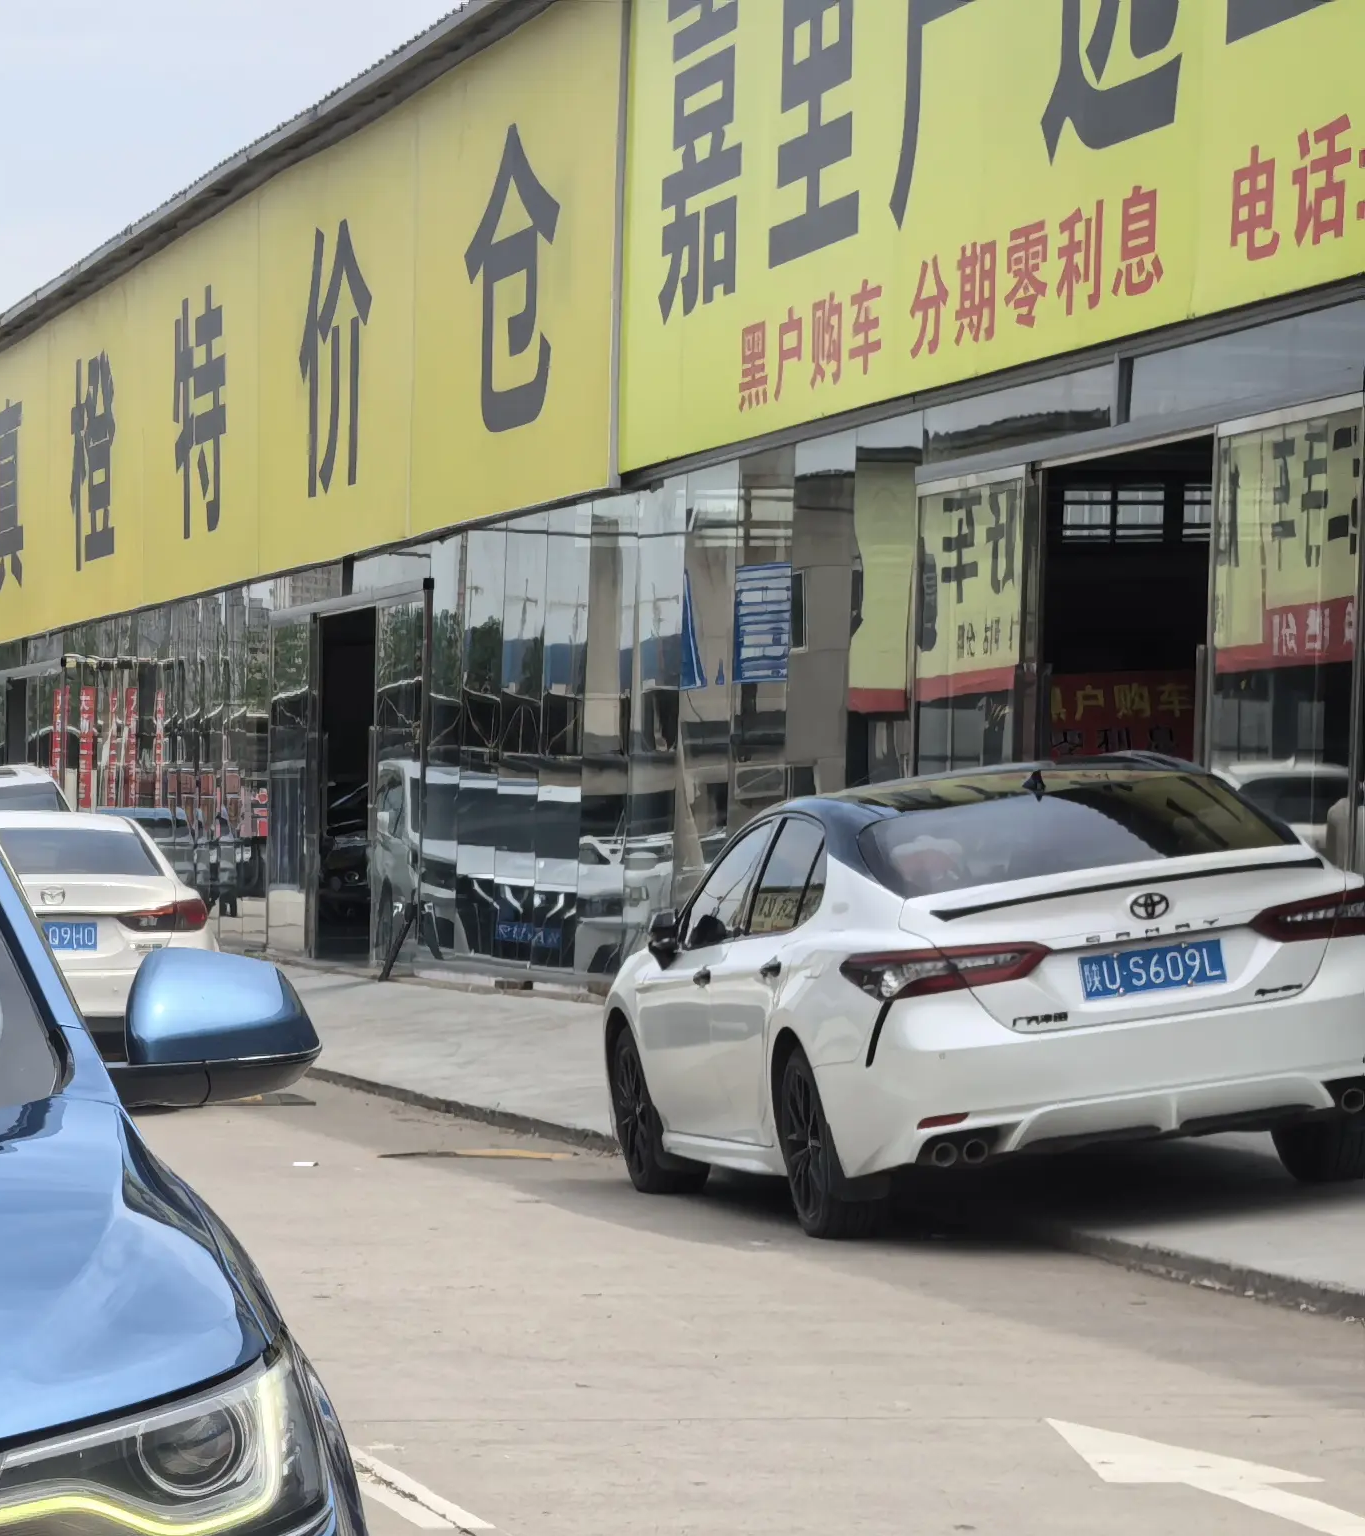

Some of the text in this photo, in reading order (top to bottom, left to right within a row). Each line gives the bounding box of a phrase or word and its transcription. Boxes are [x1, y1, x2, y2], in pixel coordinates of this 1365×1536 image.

[738, 279, 884, 412] 黑户购车
[909, 185, 1165, 360] 分期零利息
